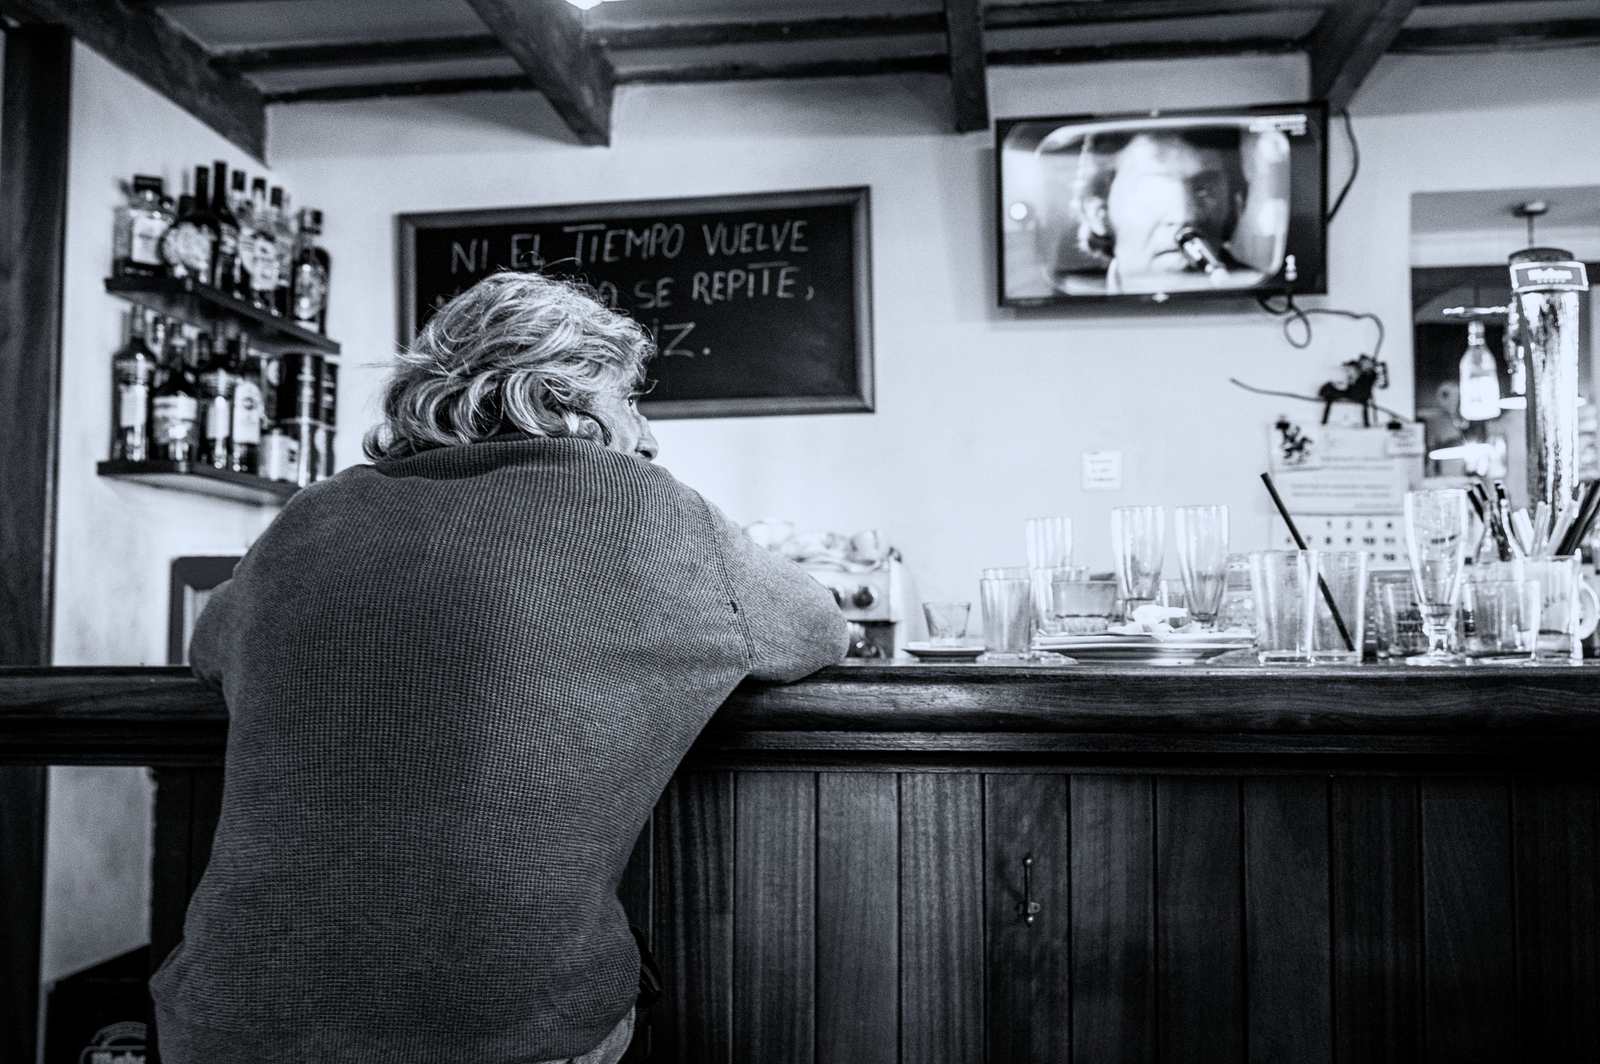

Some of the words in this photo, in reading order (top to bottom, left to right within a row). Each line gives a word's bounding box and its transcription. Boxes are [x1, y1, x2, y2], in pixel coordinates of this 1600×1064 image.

[451, 238, 489, 275] NI
[511, 233, 546, 270] EL
[562, 222, 685, 268] TIEMPO
[702, 220, 809, 256] VUELVE
[633, 276, 674, 309] SE
[691, 260, 815, 305] REPITE,
